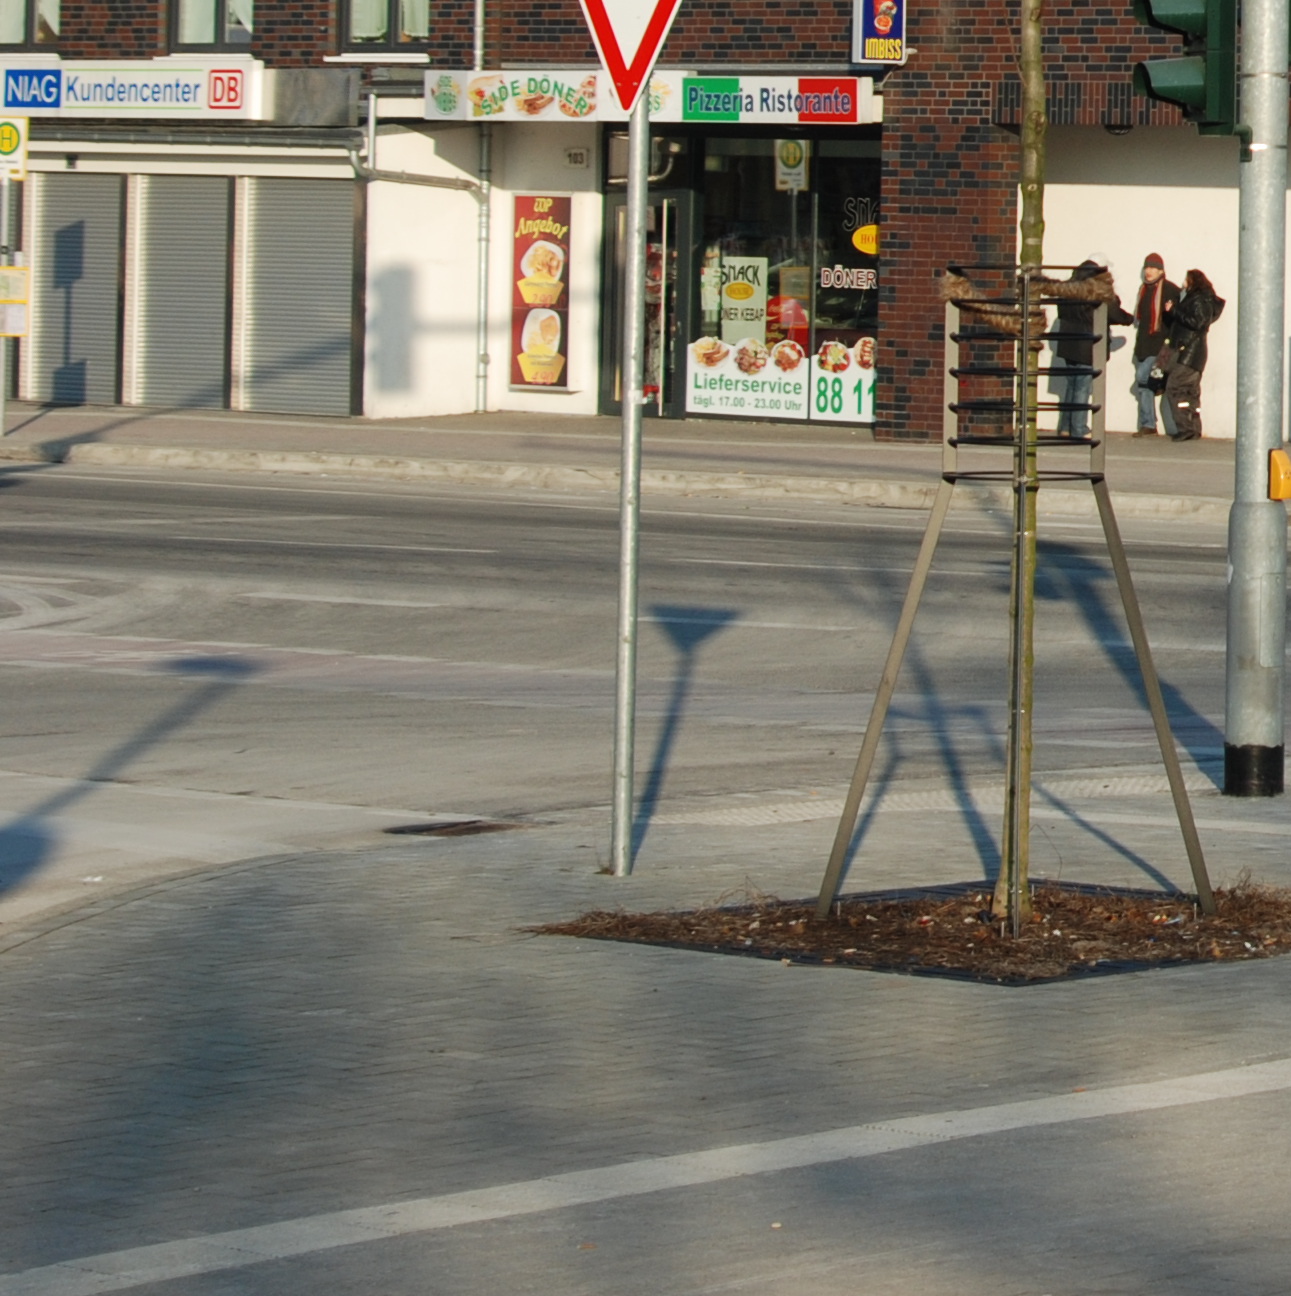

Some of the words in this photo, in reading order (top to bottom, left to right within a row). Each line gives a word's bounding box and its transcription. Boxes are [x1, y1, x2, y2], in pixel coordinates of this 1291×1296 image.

[865, 38, 902, 60] IMBISS
[7, 74, 58, 103] NIAG
[66, 75, 201, 103] Kundencenter
[212, 76, 240, 103] DB
[481, 79, 521, 116] SIDE
[527, 74, 588, 116] DÖNER
[687, 86, 754, 113] Pizzeria
[759, 87, 851, 114] Ristorante
[567, 152, 584, 164] 103
[720, 264, 761, 286] SNACK
[820, 264, 878, 289] DÖNER
[693, 372, 803, 395] Lieferservice
[815, 376, 843, 414] 88
[693, 396, 715, 408] tägl.
[719, 396, 745, 408] 17.00
[754, 398, 781, 410] 23.00
[784, 399, 802, 411] Uhr
